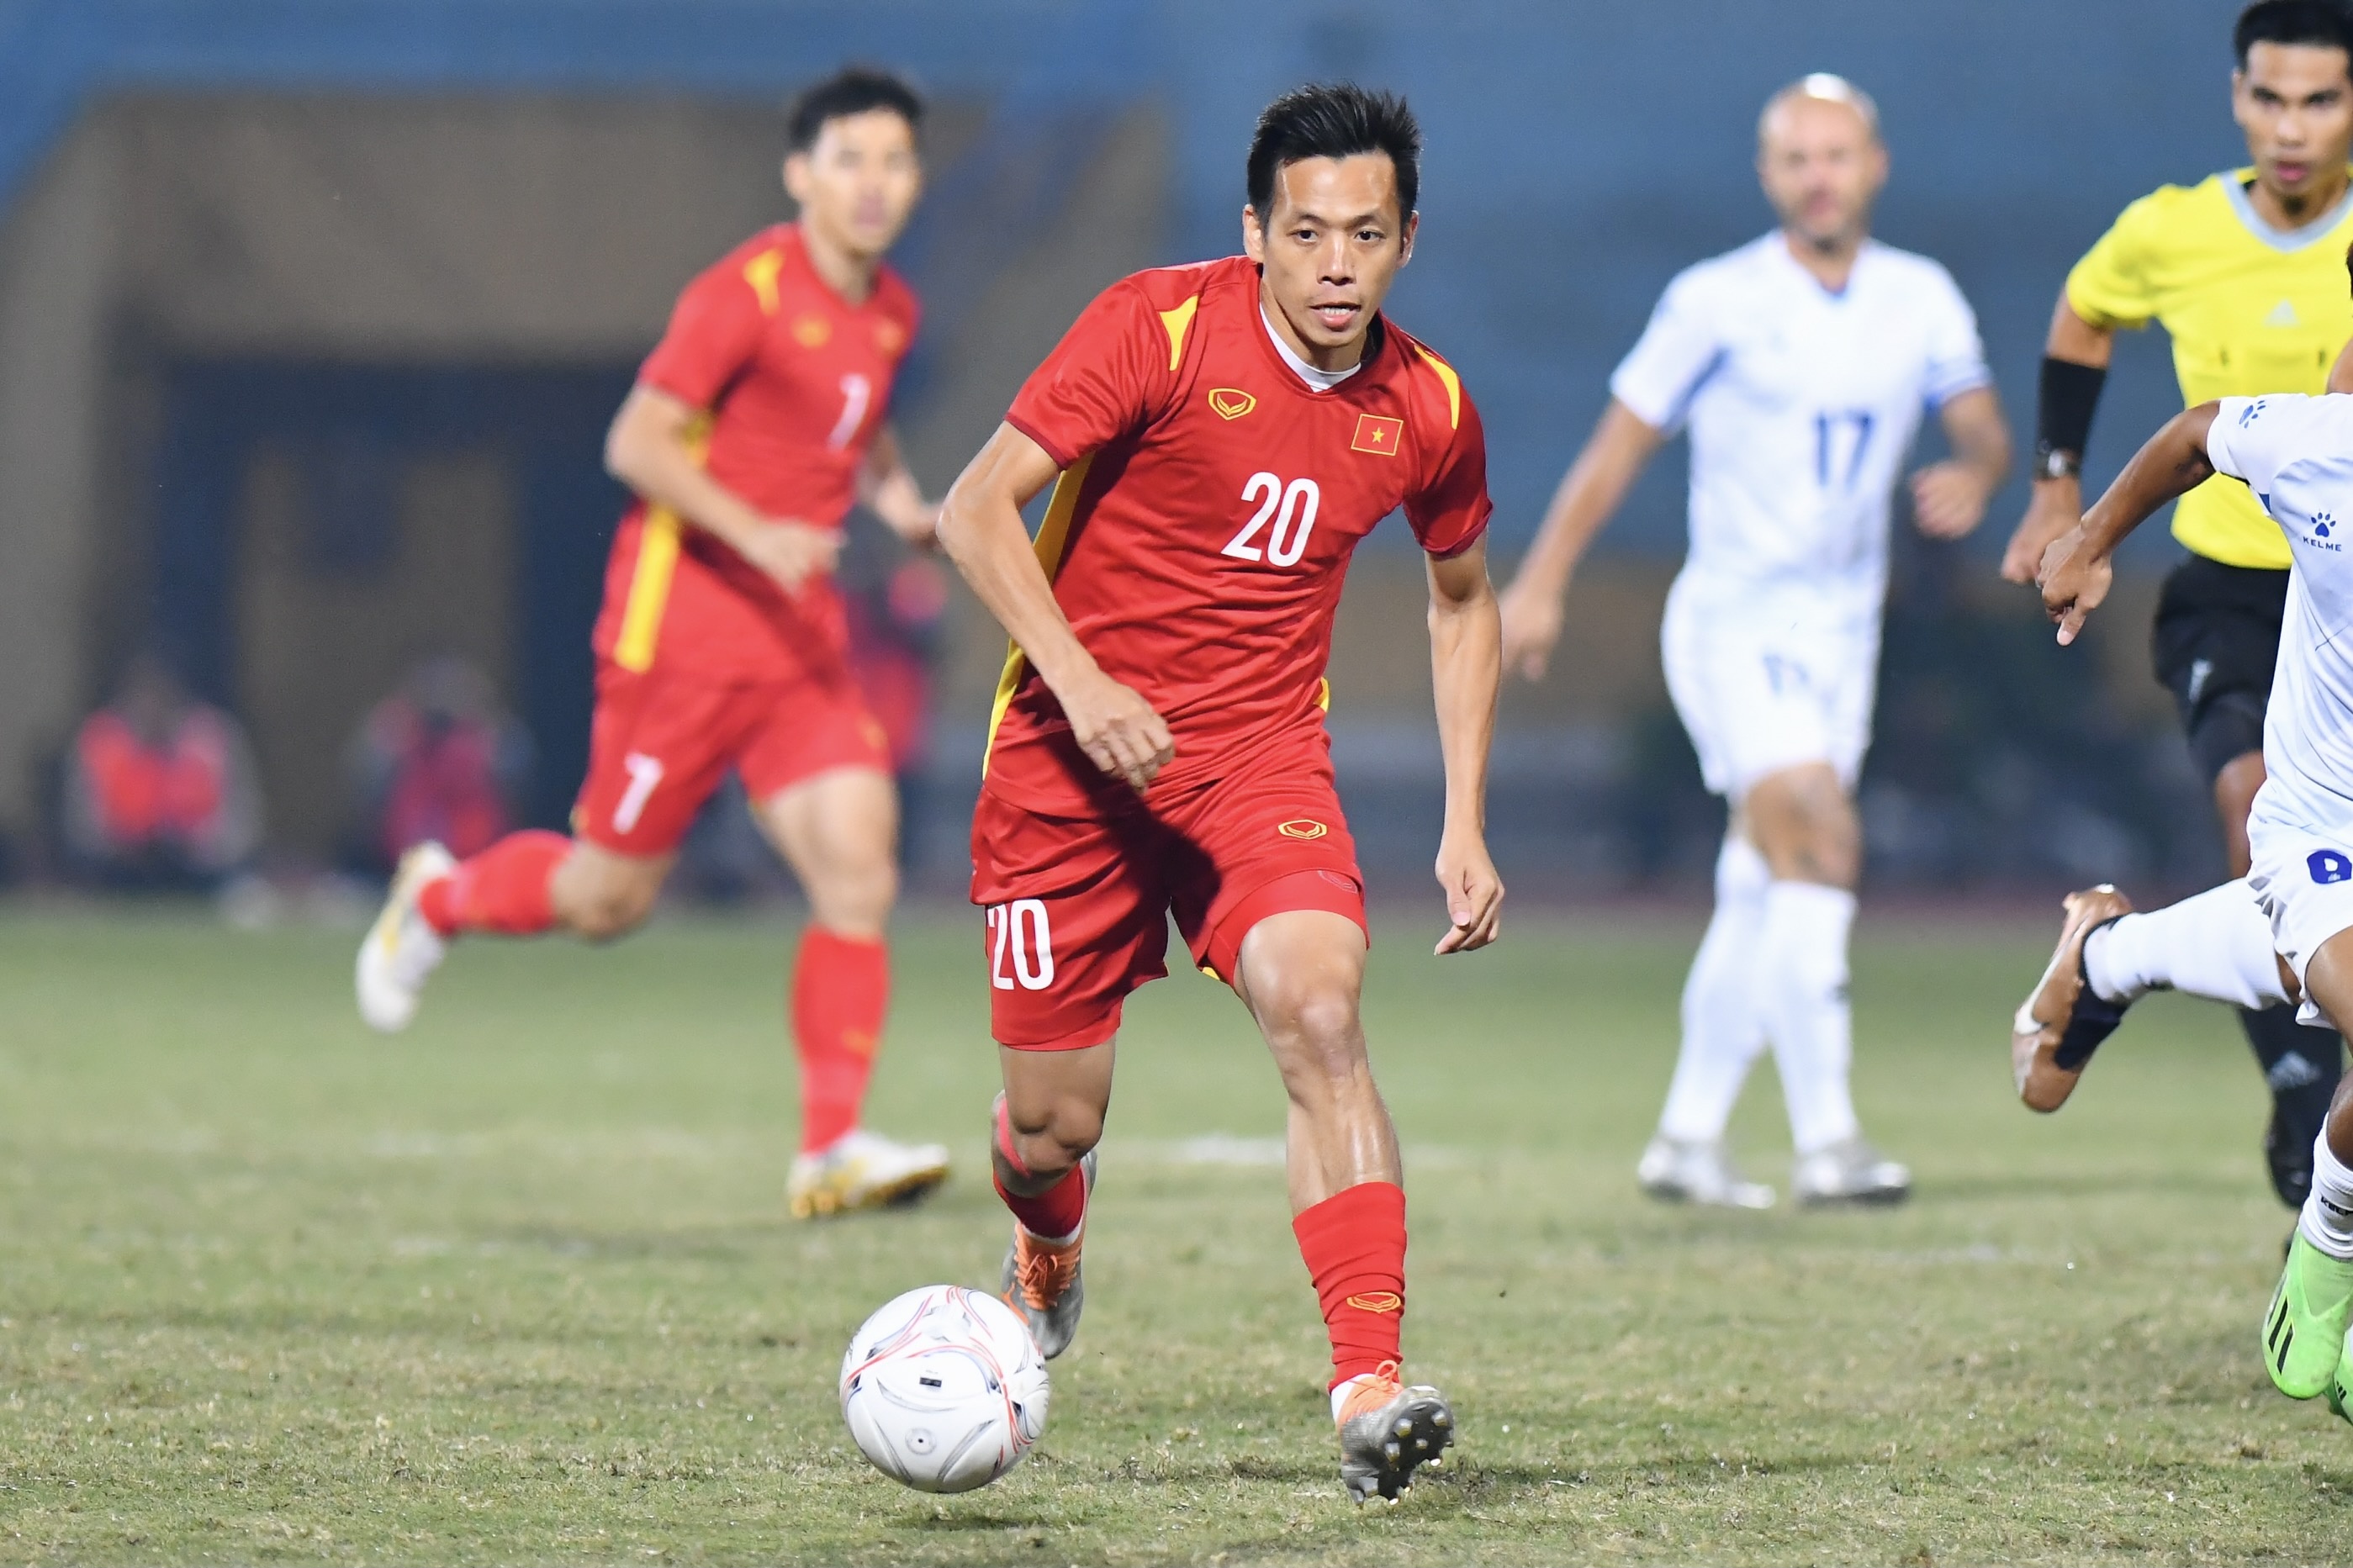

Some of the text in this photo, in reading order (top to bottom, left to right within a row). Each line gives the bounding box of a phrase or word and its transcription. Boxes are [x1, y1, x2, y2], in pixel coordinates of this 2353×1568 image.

[1813, 409, 1874, 492] 17
[1220, 471, 1319, 568] 20
[2303, 536, 2342, 552] KELME
[986, 899, 1055, 990] 20
